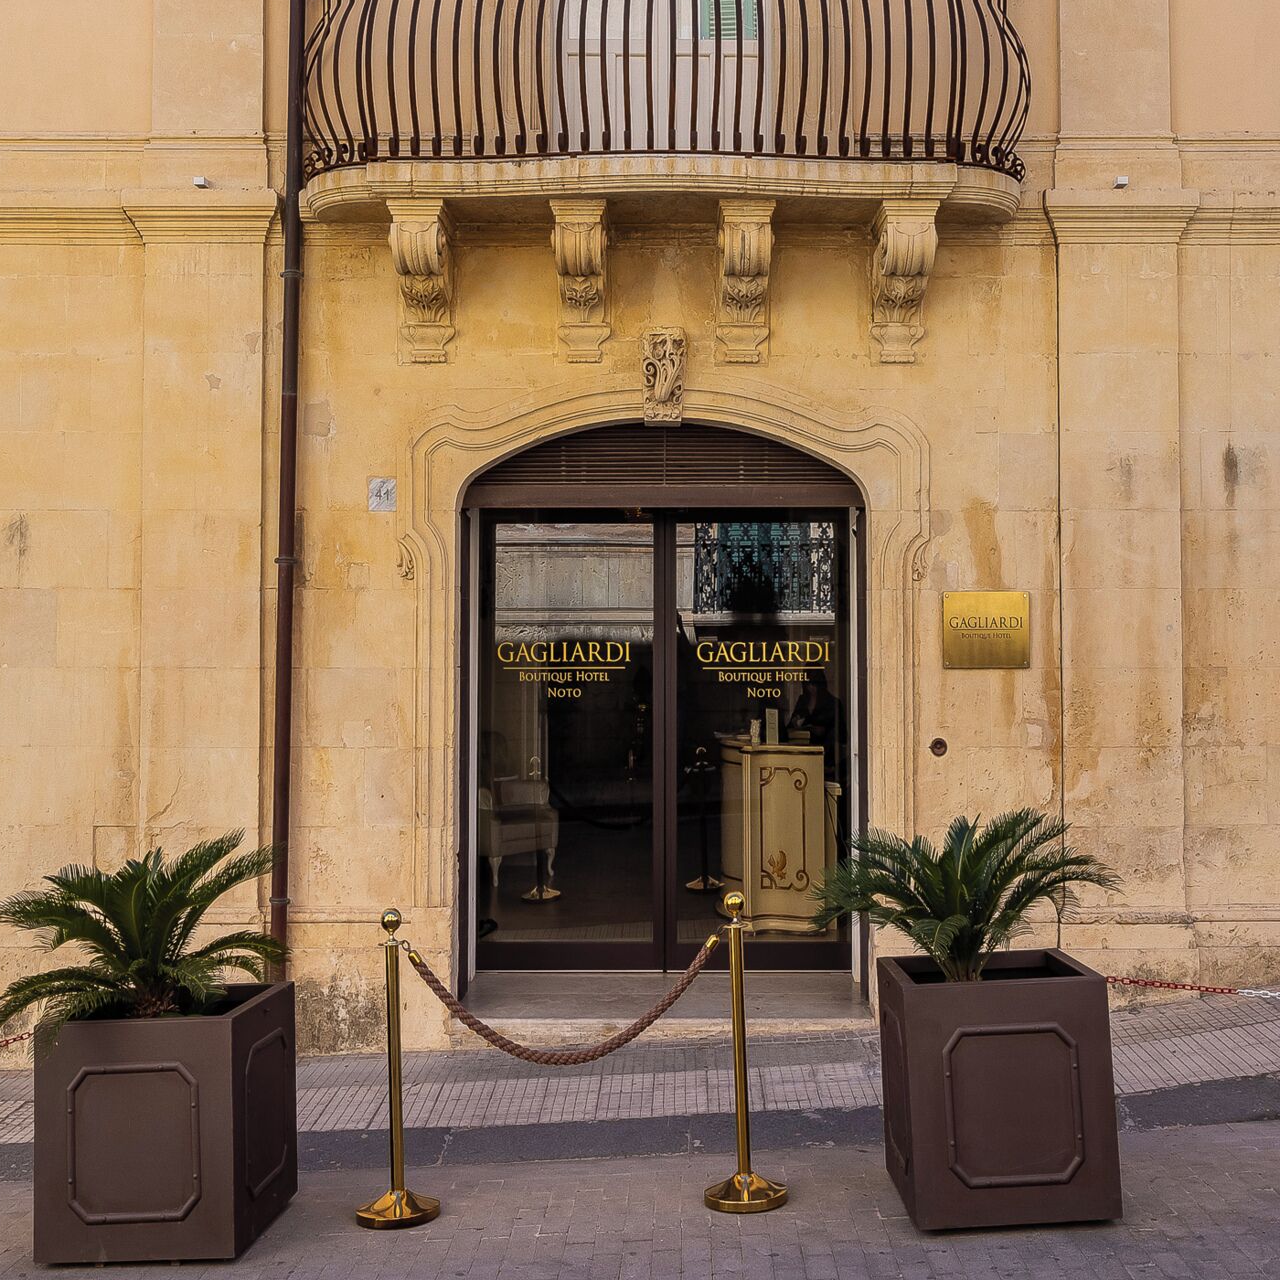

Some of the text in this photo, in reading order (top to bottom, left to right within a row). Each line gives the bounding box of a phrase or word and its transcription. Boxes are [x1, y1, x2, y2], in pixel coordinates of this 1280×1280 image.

[375, 488, 389, 501] 41
[949, 616, 1023, 629] GAGLIARDI
[497, 641, 631, 662] GAGLIARDI
[696, 641, 830, 662] GAGLIARDI
